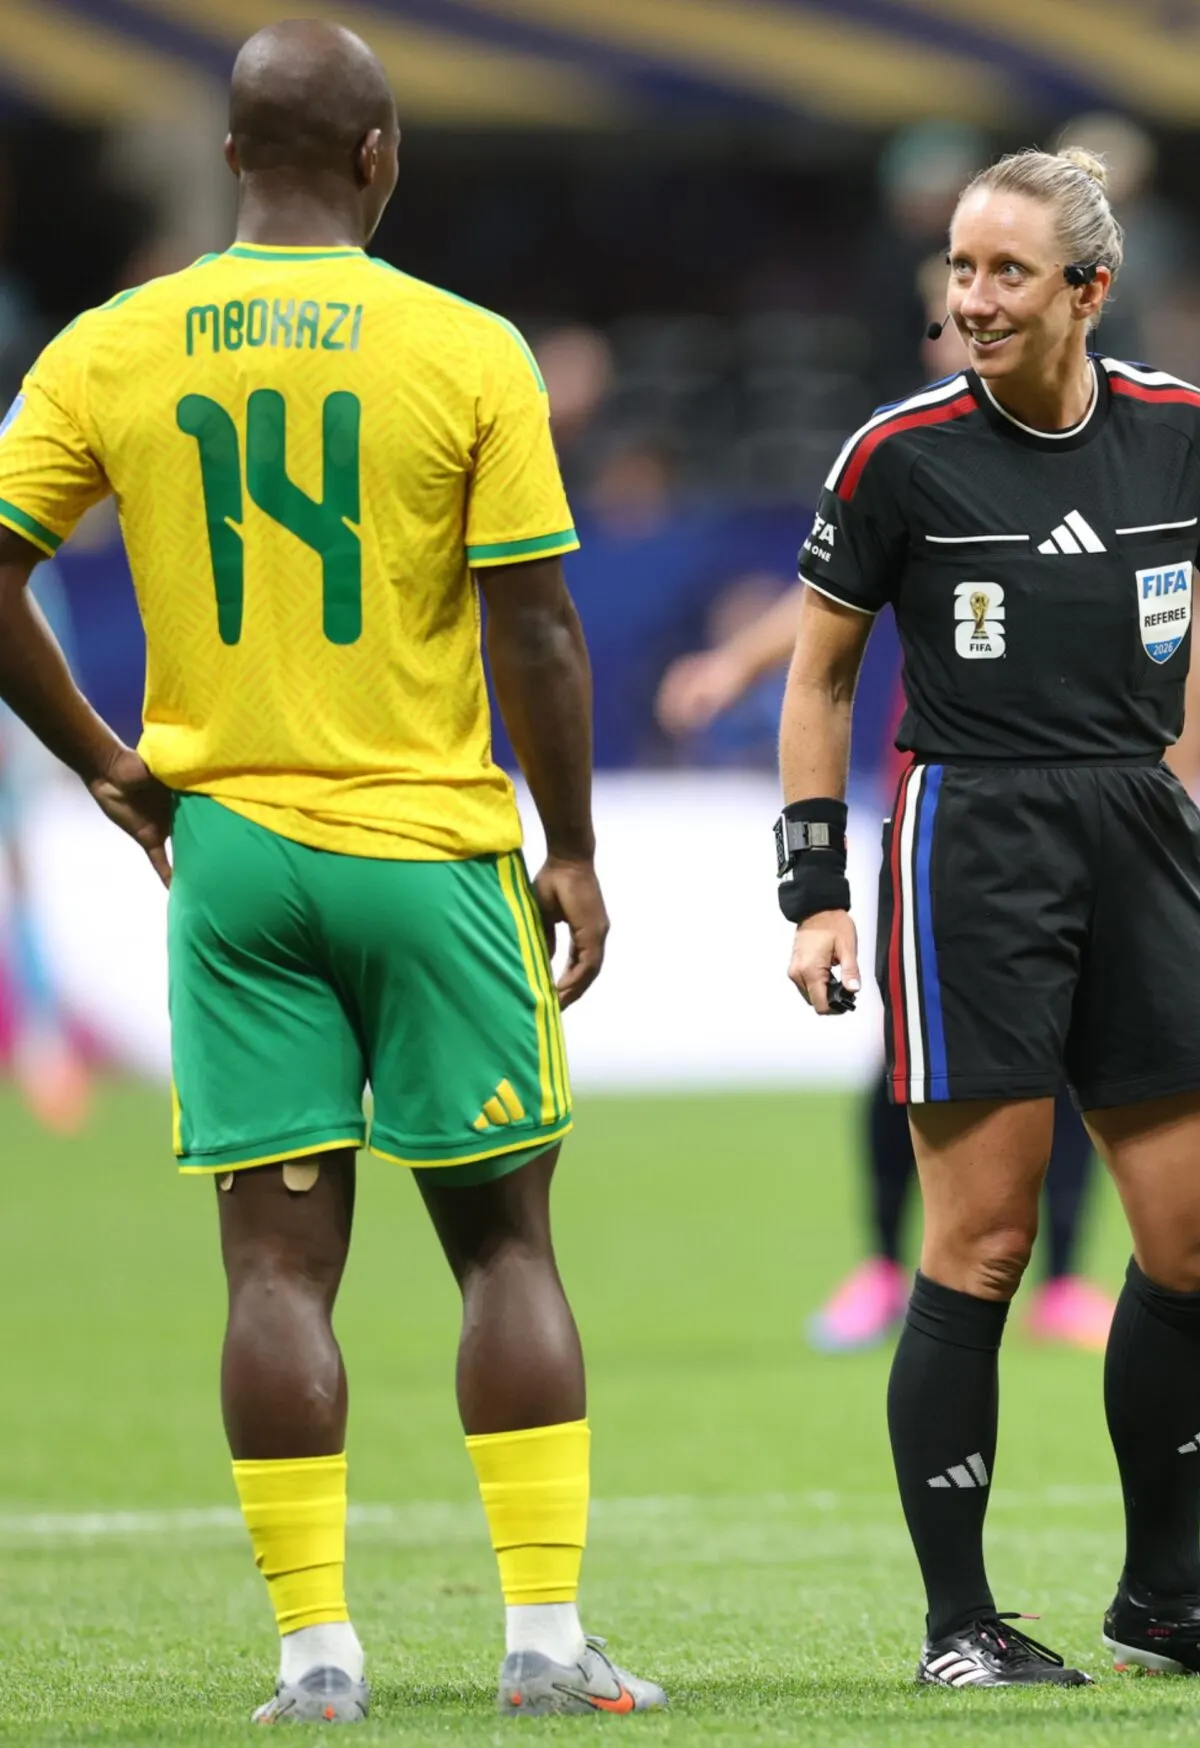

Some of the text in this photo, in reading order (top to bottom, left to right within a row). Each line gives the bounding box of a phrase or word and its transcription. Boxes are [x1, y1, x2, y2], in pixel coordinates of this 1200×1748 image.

[186, 299, 363, 357] MBOKAZI
[176, 388, 362, 646] 14
[812, 512, 834, 547] FA
[811, 545, 832, 563] ONE
[1143, 569, 1188, 599] FIFA
[1144, 607, 1187, 628] REFEREE
[969, 643, 992, 652] FIFA
[1153, 642, 1174, 656] 2026
